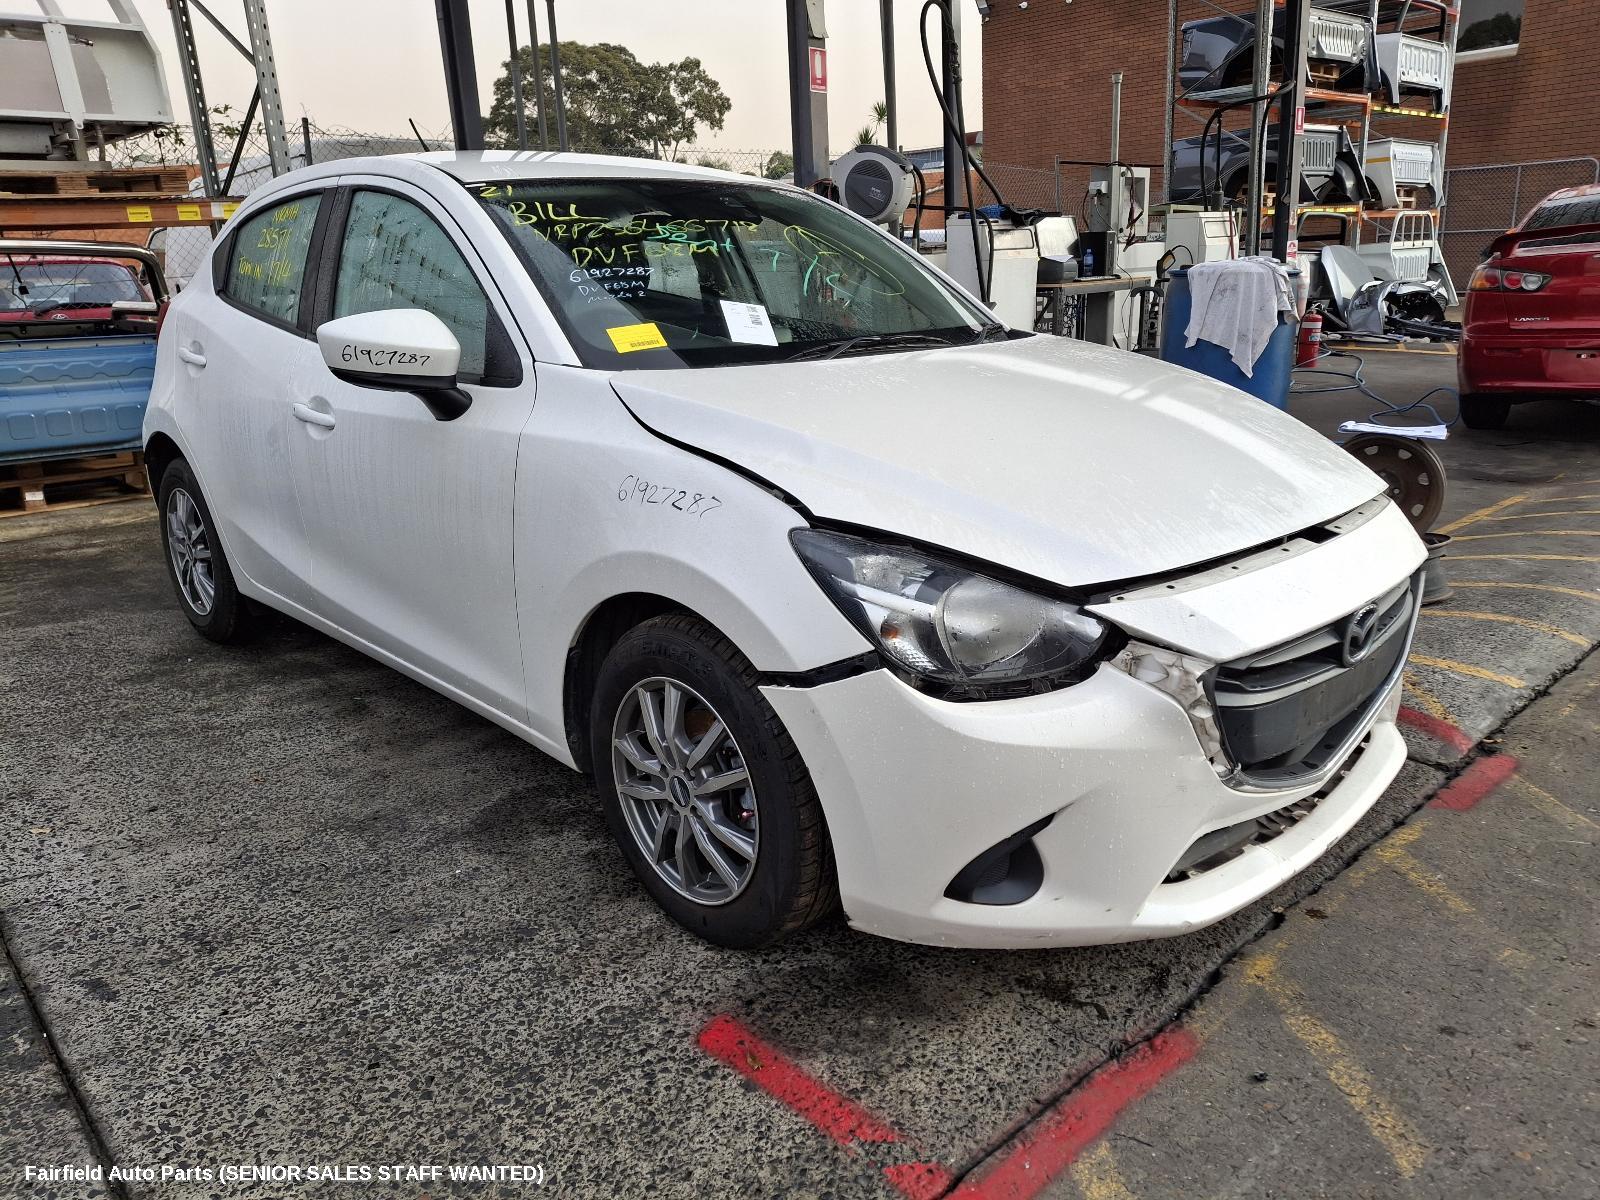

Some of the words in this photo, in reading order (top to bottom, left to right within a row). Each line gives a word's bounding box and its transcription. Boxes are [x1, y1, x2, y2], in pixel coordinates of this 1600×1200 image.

[508, 201, 610, 226] BILL
[569, 267, 655, 283] 61927287
[341, 344, 431, 366] 61927287
[618, 474, 723, 518] 61927287
